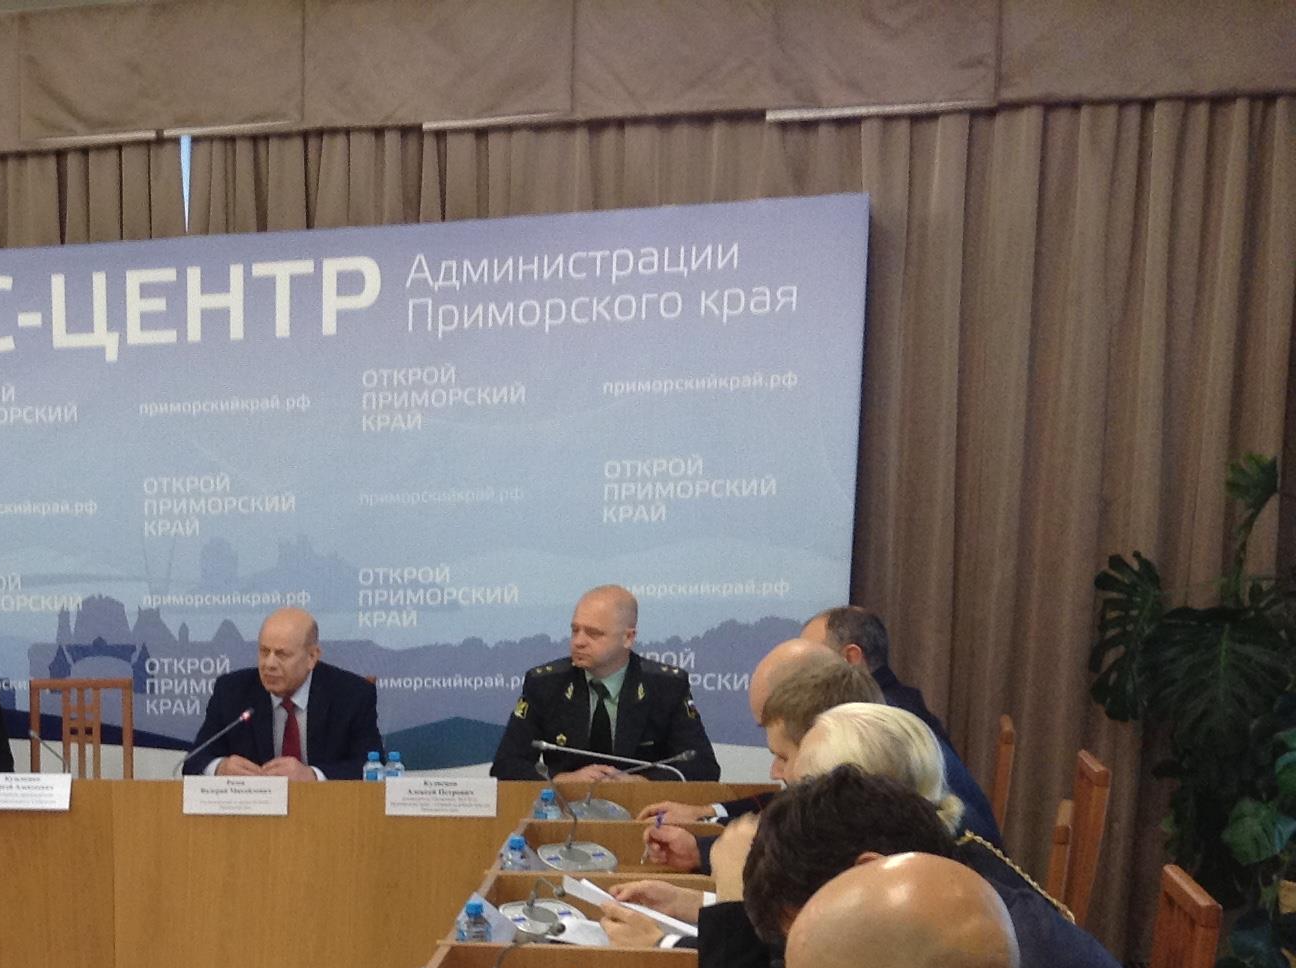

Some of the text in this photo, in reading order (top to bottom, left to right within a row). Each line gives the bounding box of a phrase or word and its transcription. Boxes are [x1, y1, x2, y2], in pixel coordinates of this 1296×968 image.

[405, 241, 741, 291] Администрации
[407, 283, 799, 339] Приморского края
[361, 361, 456, 388] ОТКРОЙ
[603, 369, 799, 397] приморскийкрай.рф
[138, 393, 311, 418] приморскийкрай.рф
[361, 384, 527, 410] ПРИМОРСКИЙ
[361, 408, 423, 433] КРАЙ
[603, 452, 705, 481] ОТКРОЙ
[142, 473, 231, 496] ОТКРОЙ
[603, 474, 778, 502] ПРИМОРСКИЙ
[142, 492, 297, 516] ПРИМОРСКИЙ
[602, 499, 667, 524] КРАЙ
[142, 516, 201, 538] КРАЙ
[358, 562, 451, 586] ОТКРОЙ
[142, 588, 311, 608] приморскийкрай.рф
[358, 582, 520, 607] ПРИМОРСКИЙ
[628, 577, 791, 598] морскийкрай.рф
[357, 606, 418, 628] КРАЙ
[144, 653, 231, 675] ОТКРОЙ
[377, 672, 526, 692] иморскийкрай.р
[145, 694, 201, 716] КРАЙ
